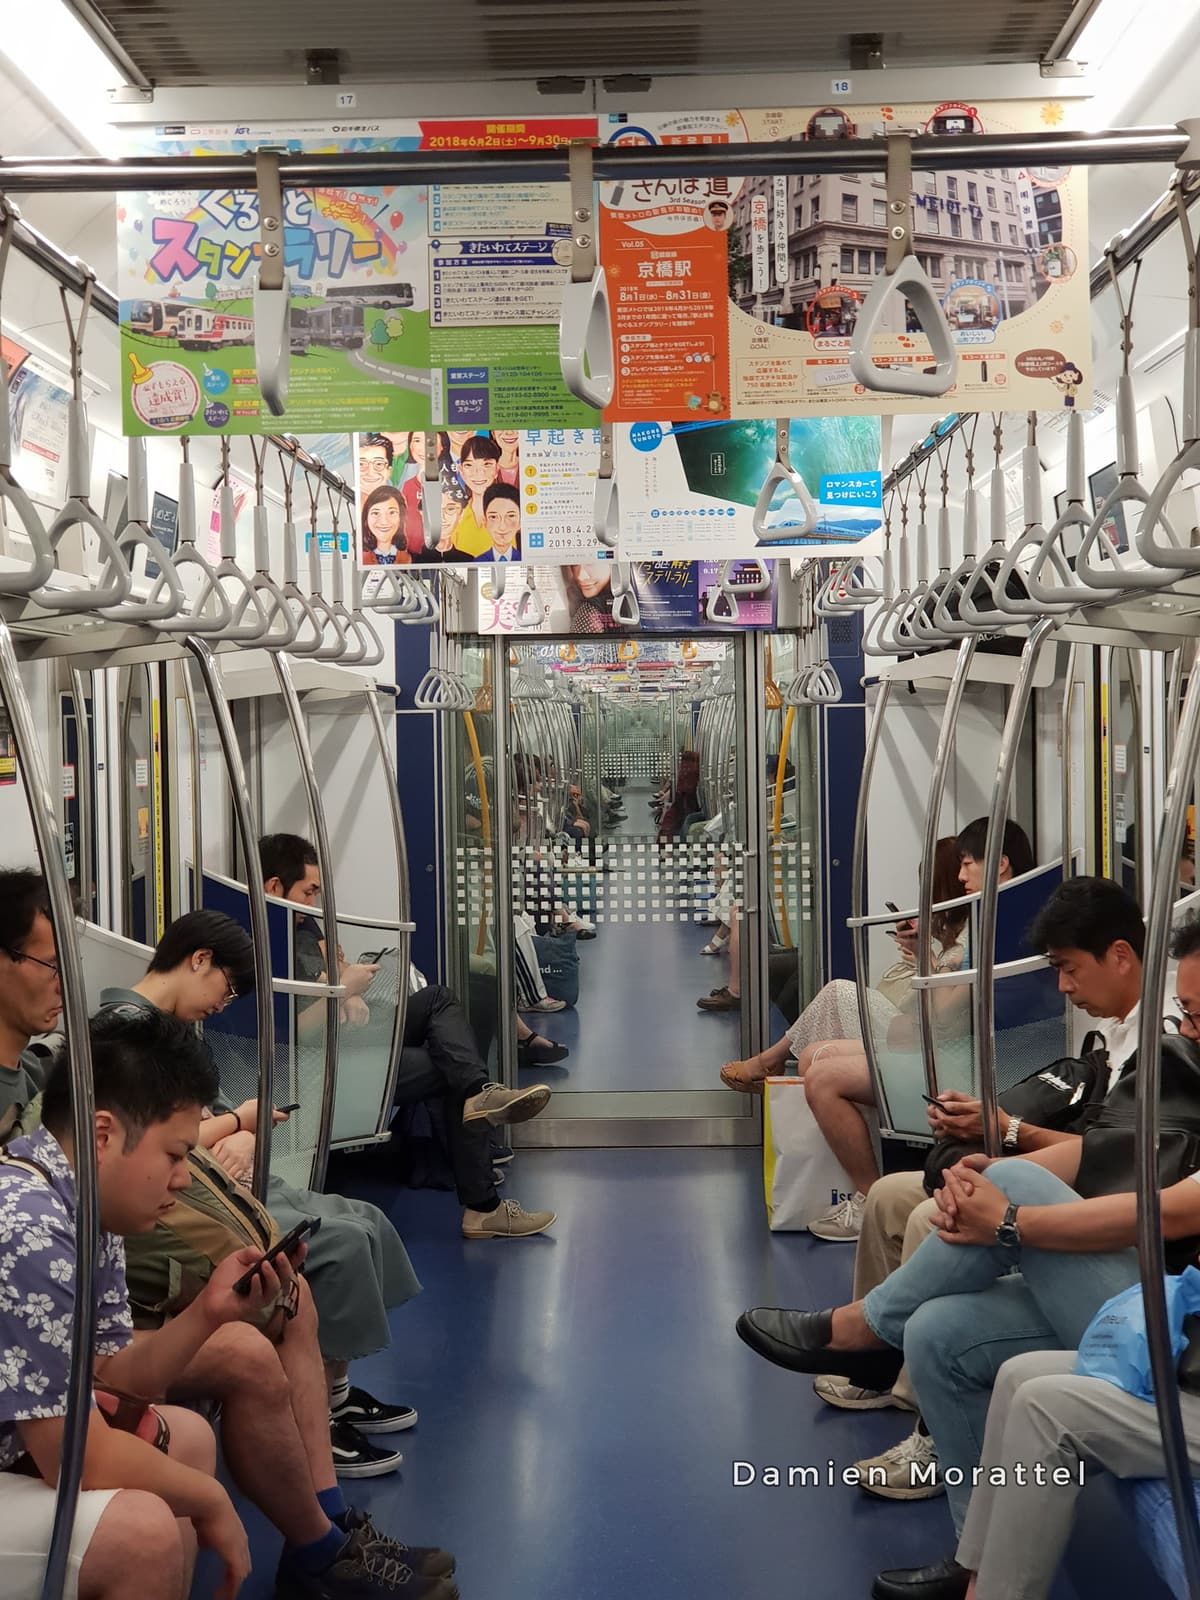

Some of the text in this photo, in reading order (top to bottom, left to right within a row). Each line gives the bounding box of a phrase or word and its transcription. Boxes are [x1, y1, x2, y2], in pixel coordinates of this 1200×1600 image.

[834, 81, 849, 92] 18
[339, 95, 353, 105] 17
[150, 217, 383, 282] スタンラリー
[469, 241, 548, 254] きたいわてステージ
[621, 241, 645, 249] Vol.05
[637, 260, 692, 278] 京橋駅
[457, 405, 481, 413] ステージ
[826, 480, 878, 489] ロマンスカーで
[826, 490, 878, 500] 見つけにいこう
